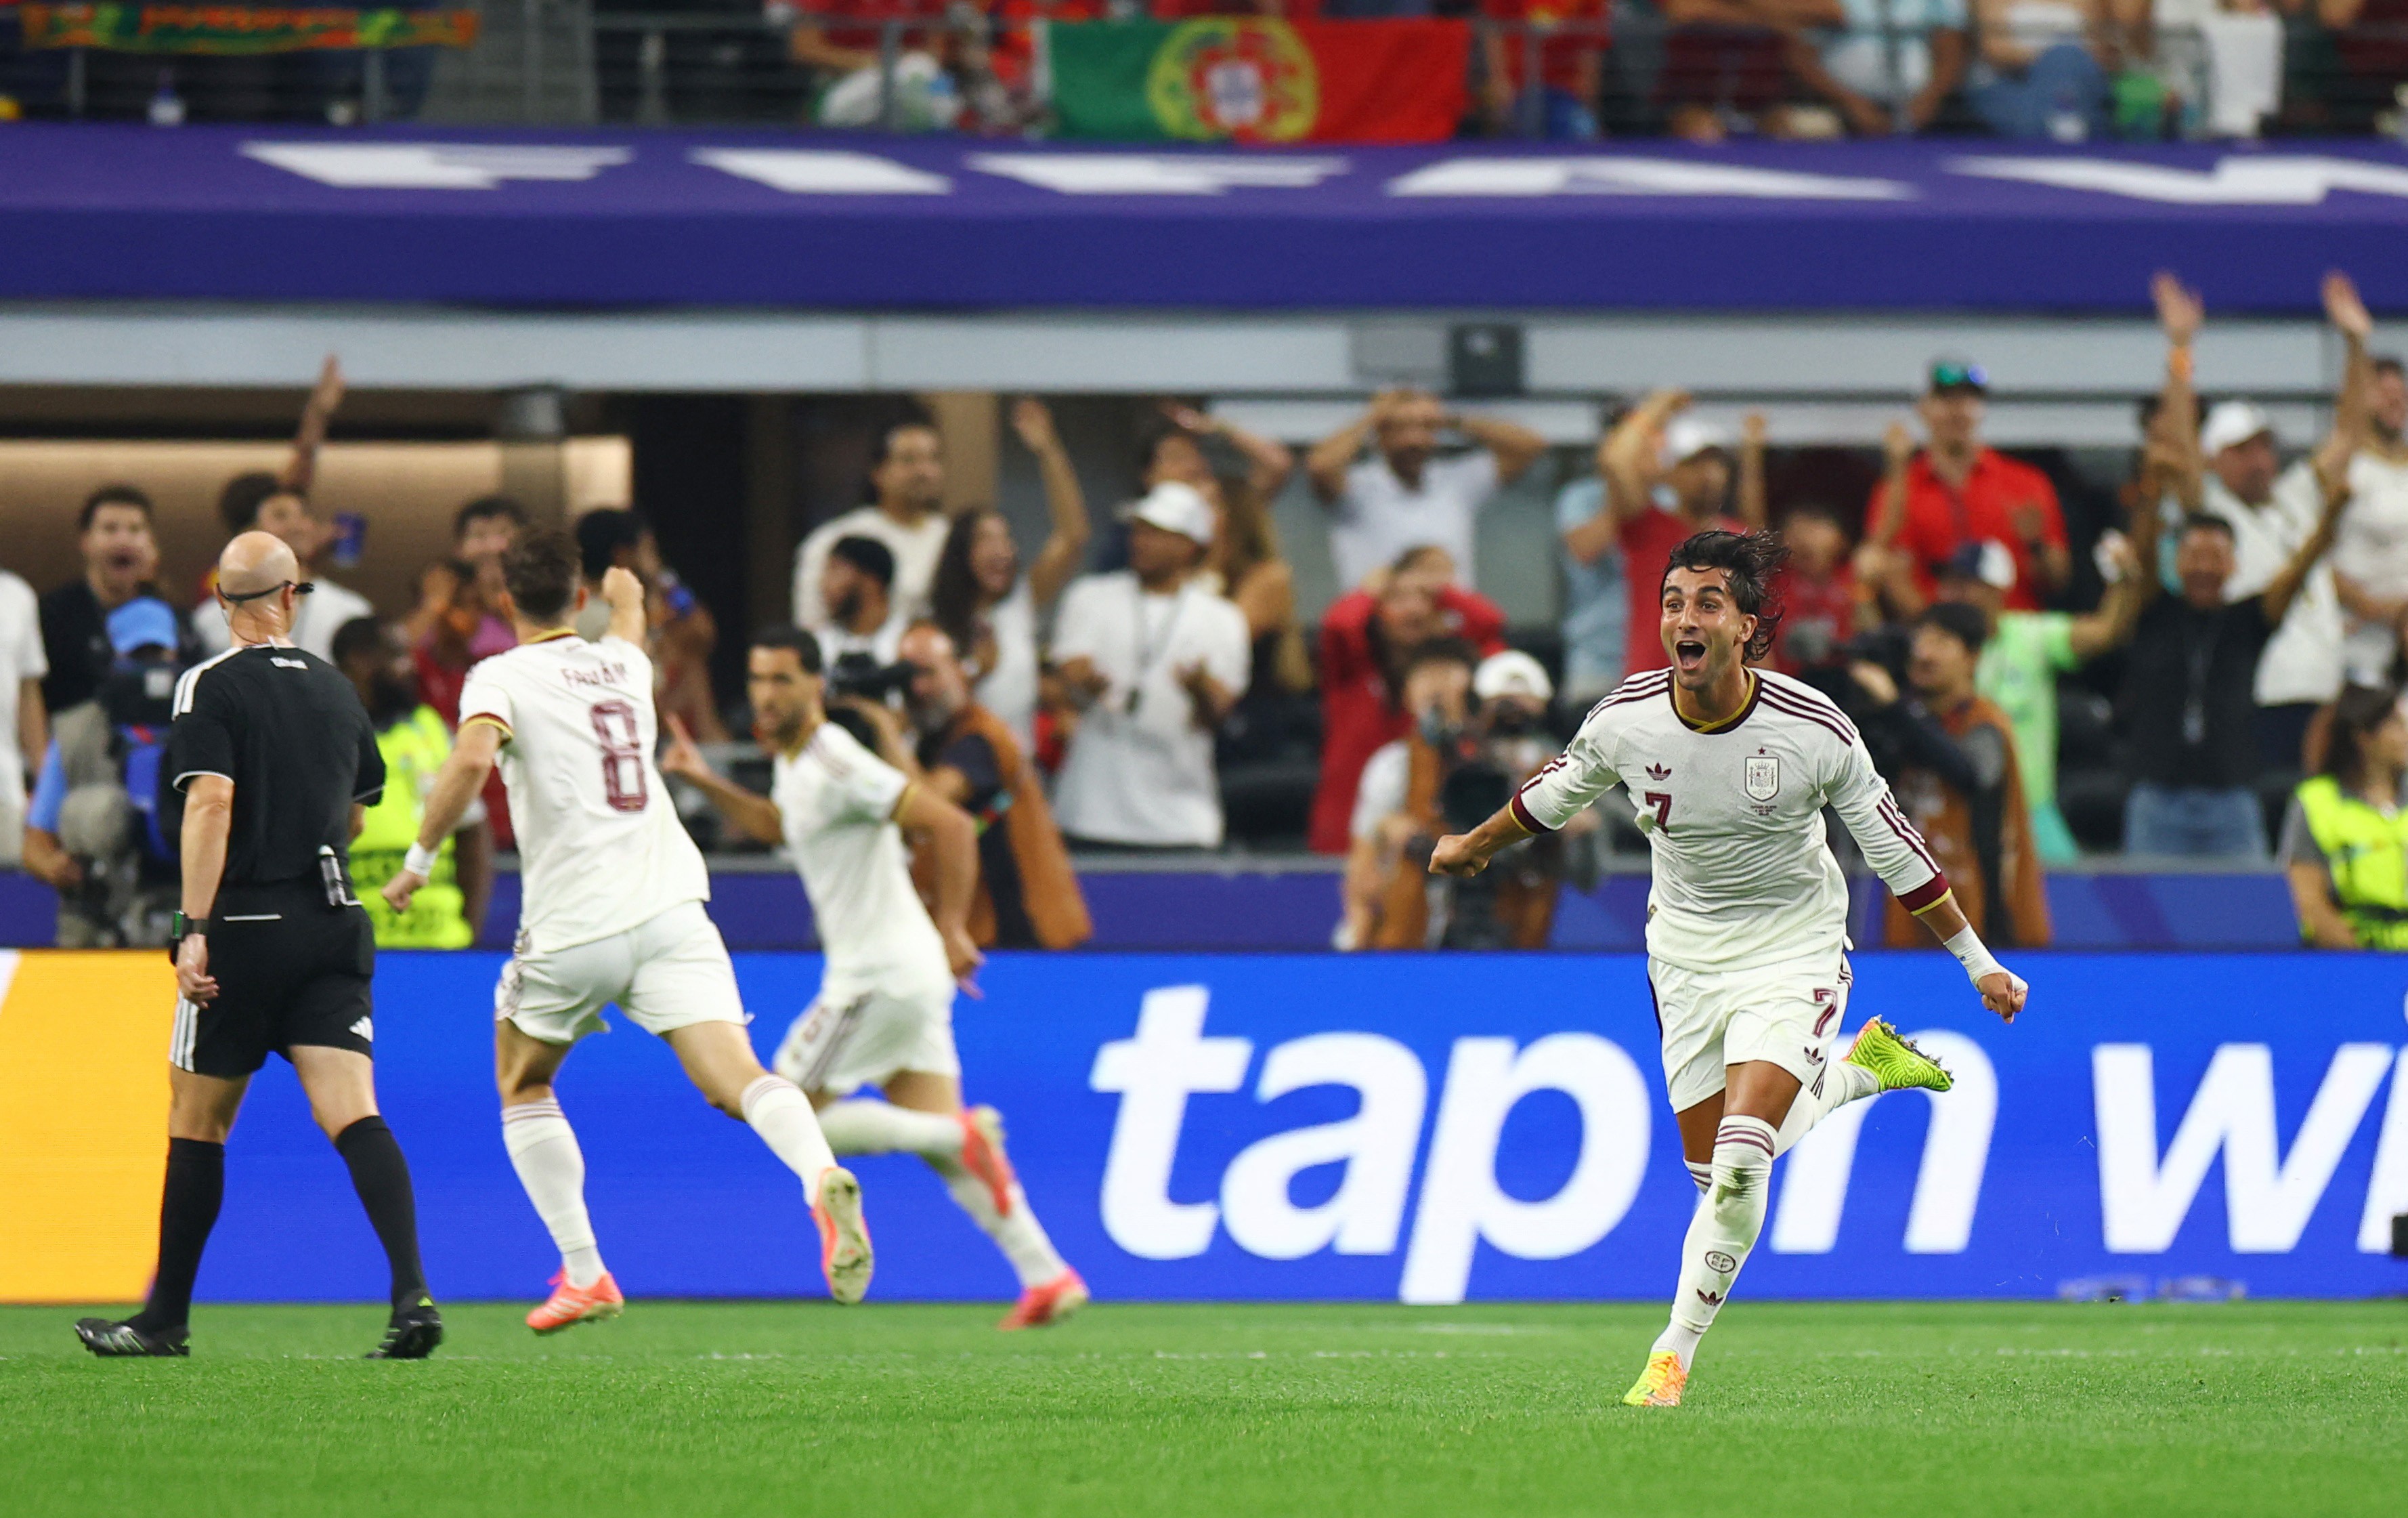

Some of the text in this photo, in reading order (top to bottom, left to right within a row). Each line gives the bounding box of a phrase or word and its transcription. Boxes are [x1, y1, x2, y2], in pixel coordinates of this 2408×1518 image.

[240, 141, 1920, 201] FIFA
[590, 699, 649, 812] 8
[1644, 790, 1672, 836] 7
[1812, 988, 1838, 1038] 7
[1088, 984, 1652, 1305] tap
[1693, 1030, 1998, 1255] n
